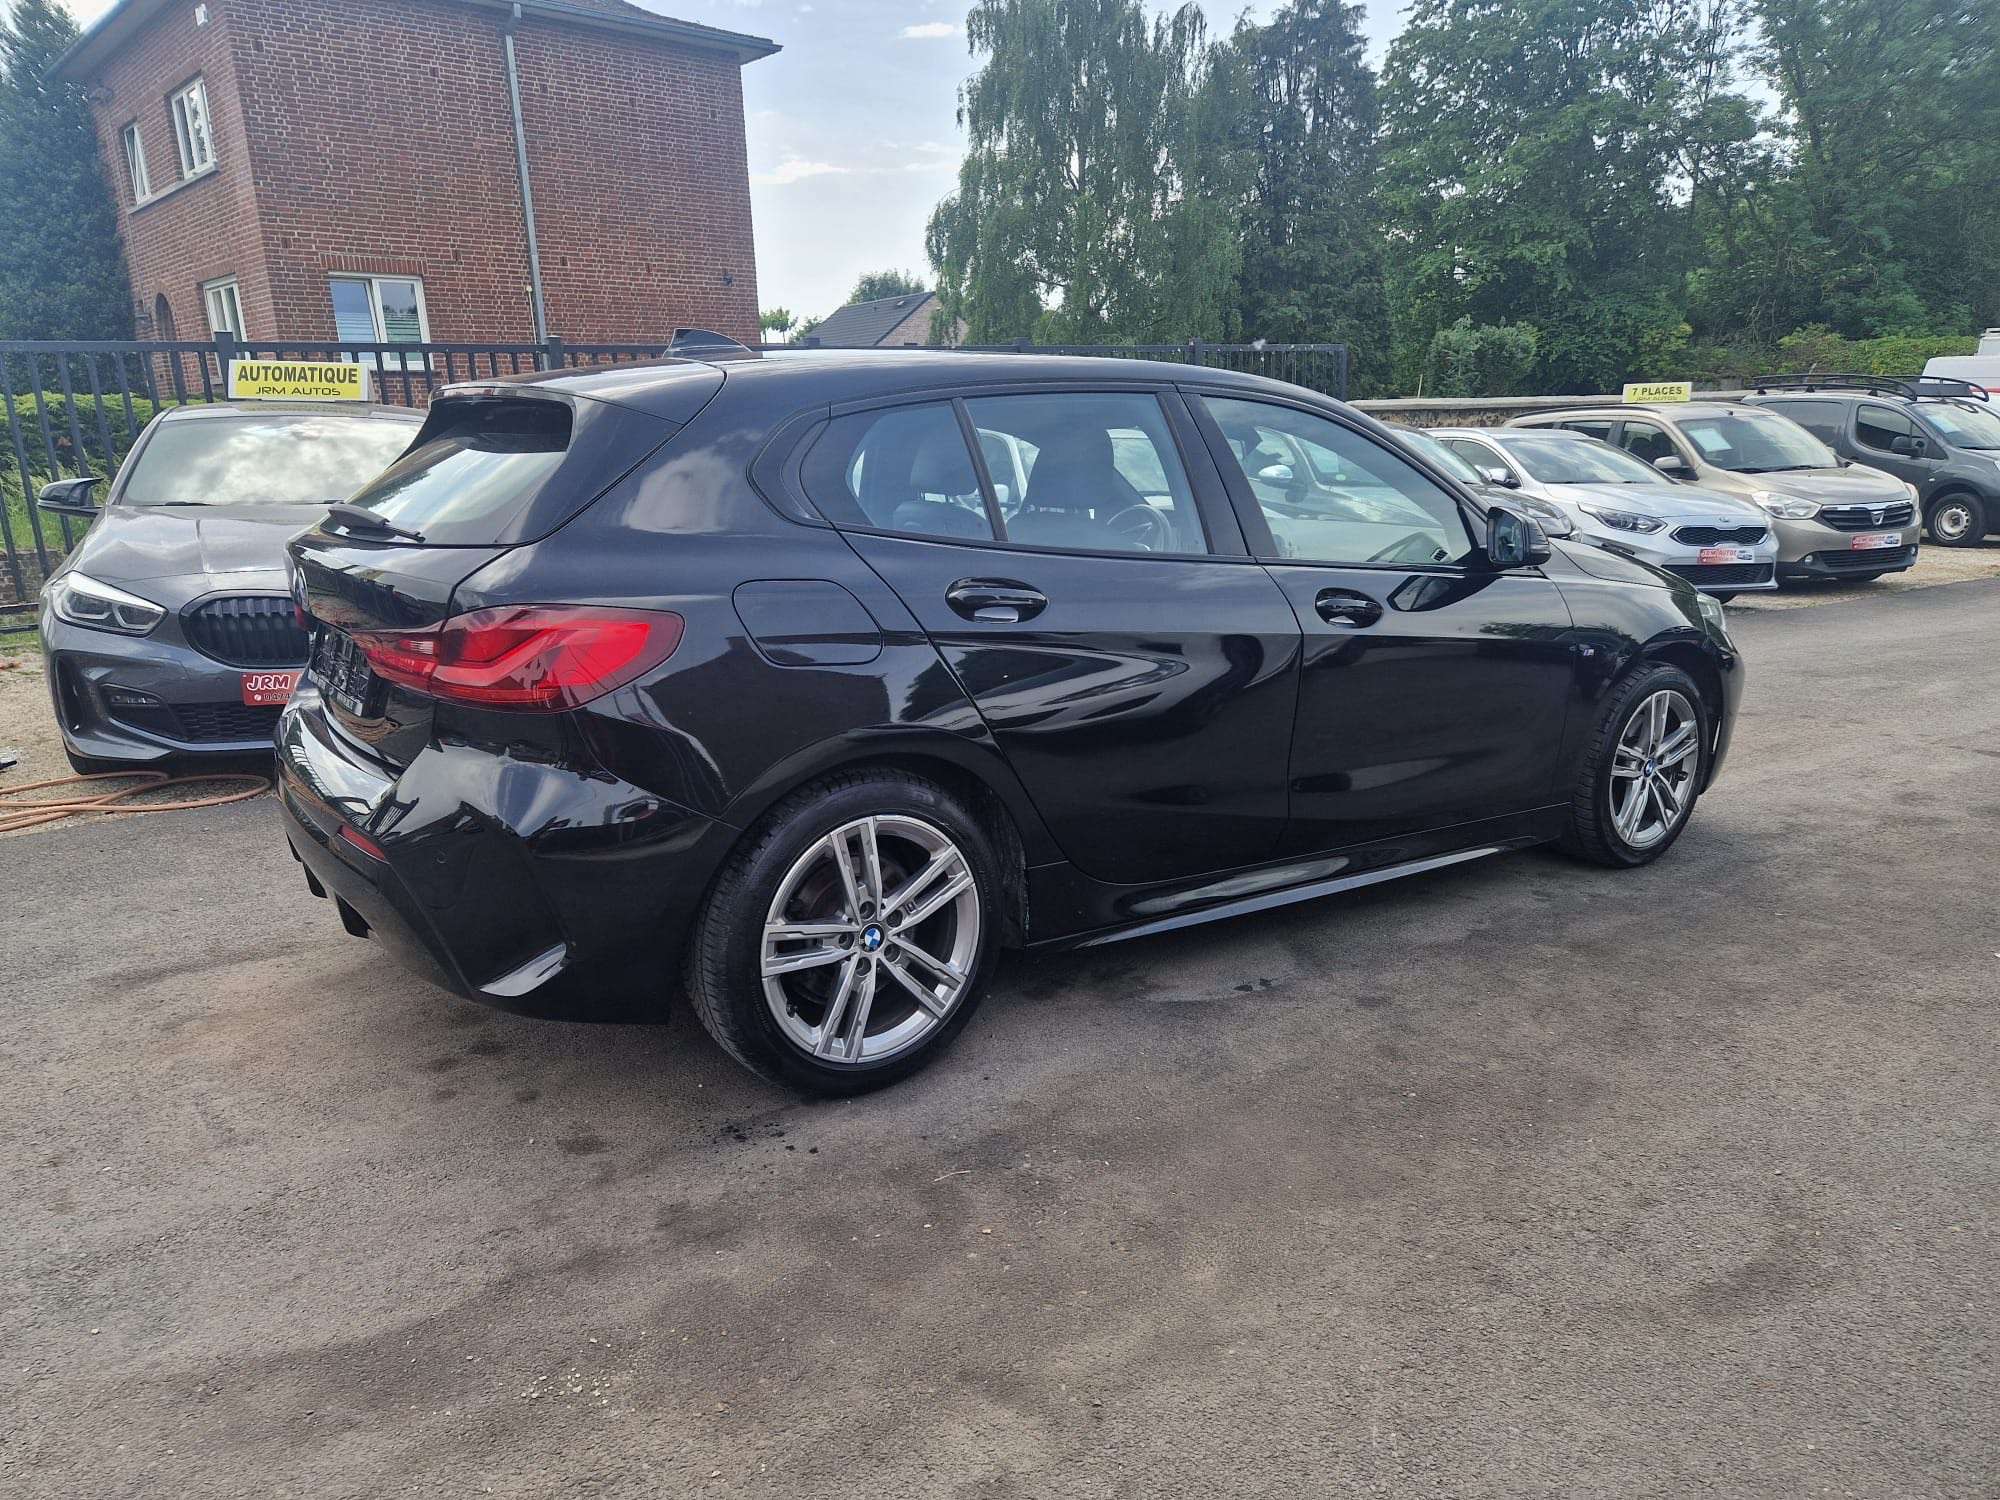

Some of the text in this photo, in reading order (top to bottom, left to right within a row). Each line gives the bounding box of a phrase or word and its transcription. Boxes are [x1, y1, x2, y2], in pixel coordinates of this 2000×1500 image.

[238, 366, 358, 384] AUTOMATIQUE
[256, 387, 341, 396] JRM AUTOS
[1632, 386, 1682, 396] 7 PLACES
[247, 674, 290, 690] JRM
